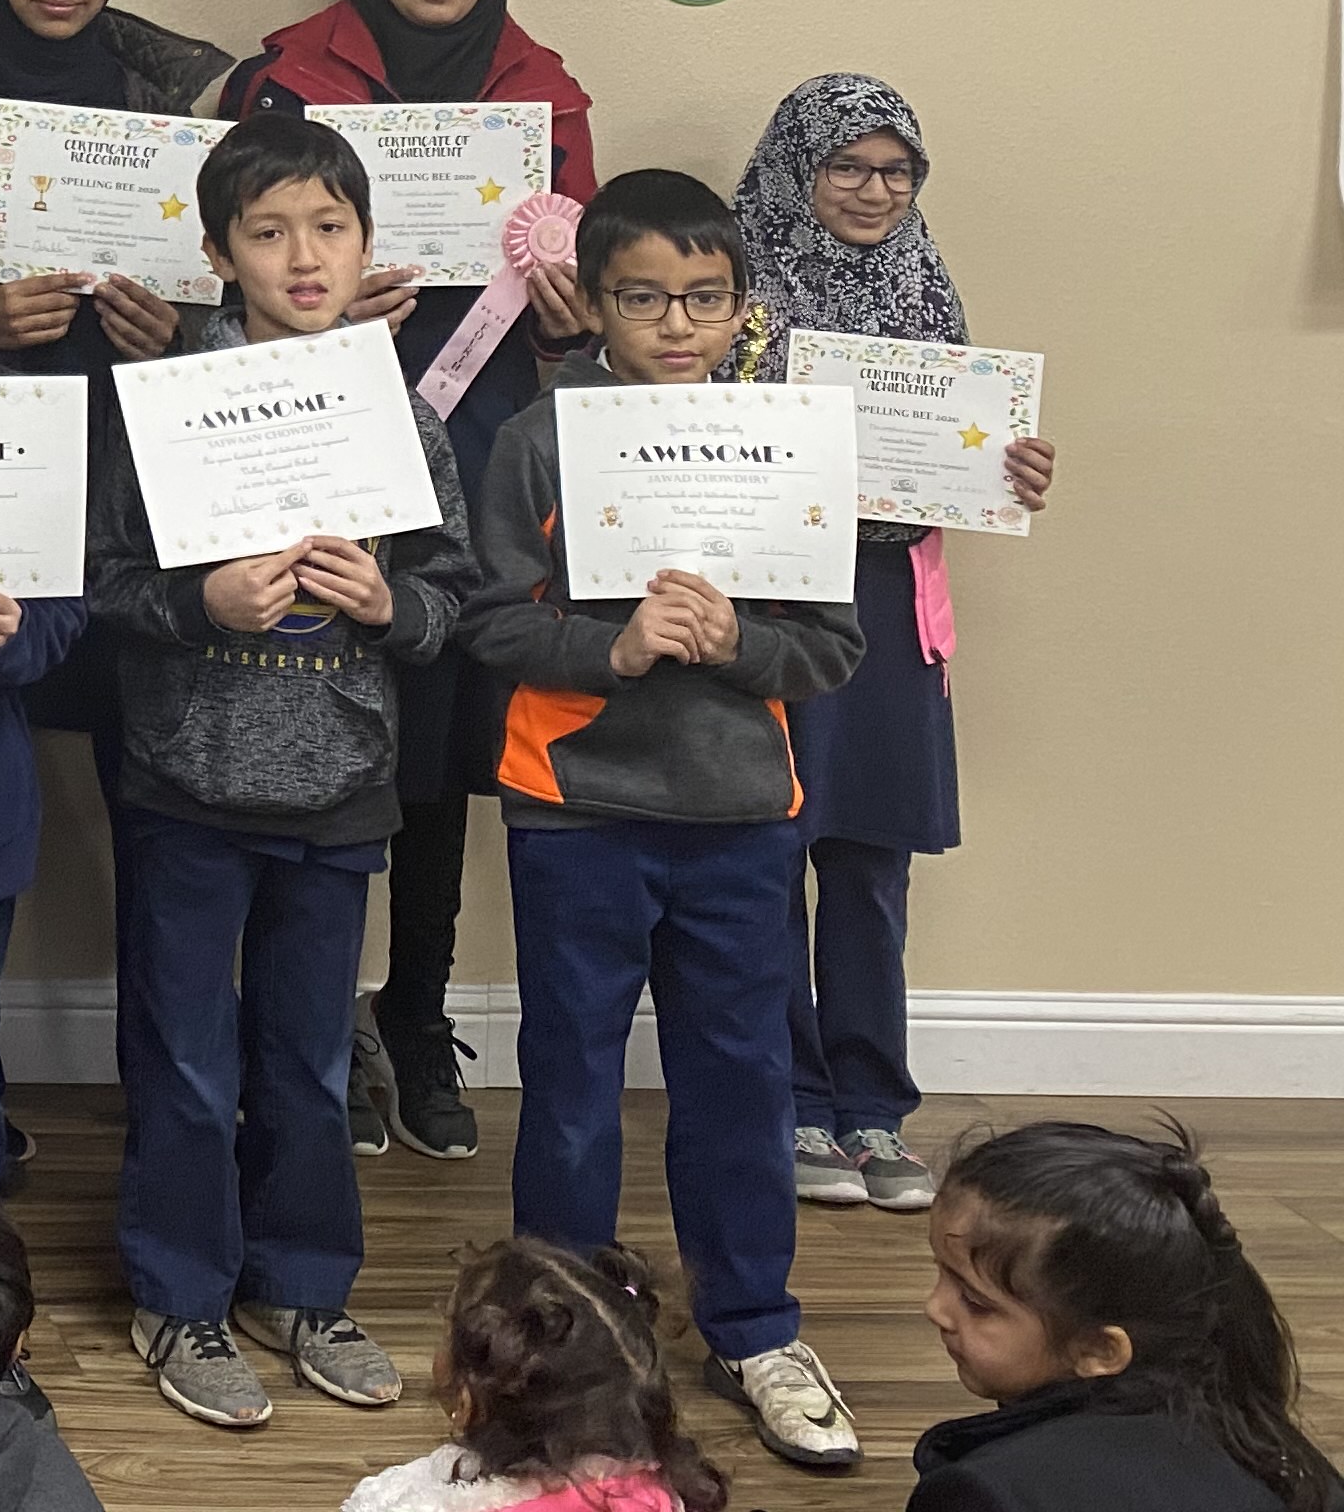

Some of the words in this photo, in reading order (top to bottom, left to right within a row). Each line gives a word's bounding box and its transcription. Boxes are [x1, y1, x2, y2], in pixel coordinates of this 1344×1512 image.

[64, 139, 138, 156] CERTIFICATE
[143, 146, 158, 158] OF
[378, 135, 450, 148] CERTIFICATE
[455, 135, 470, 146] OF
[71, 152, 150, 169] RECOGNITION
[385, 147, 463, 159] ACHIEVEMENT
[60, 176, 113, 190] SPELLING
[115, 182, 135, 192] BEE
[379, 173, 429, 182] SPELLING
[432, 173, 451, 181] BEE
[860, 368, 935, 385] CERTIFICATE
[940, 376, 956, 388] OF
[866, 381, 947, 398] ACHIEVEMENT
[198, 391, 335, 431] AWESOME
[857, 404, 909, 418] SPELLING
[913, 410, 933, 421] BEE
[935, 414, 960, 423] 2020
[632, 445, 783, 464] AWESOME
